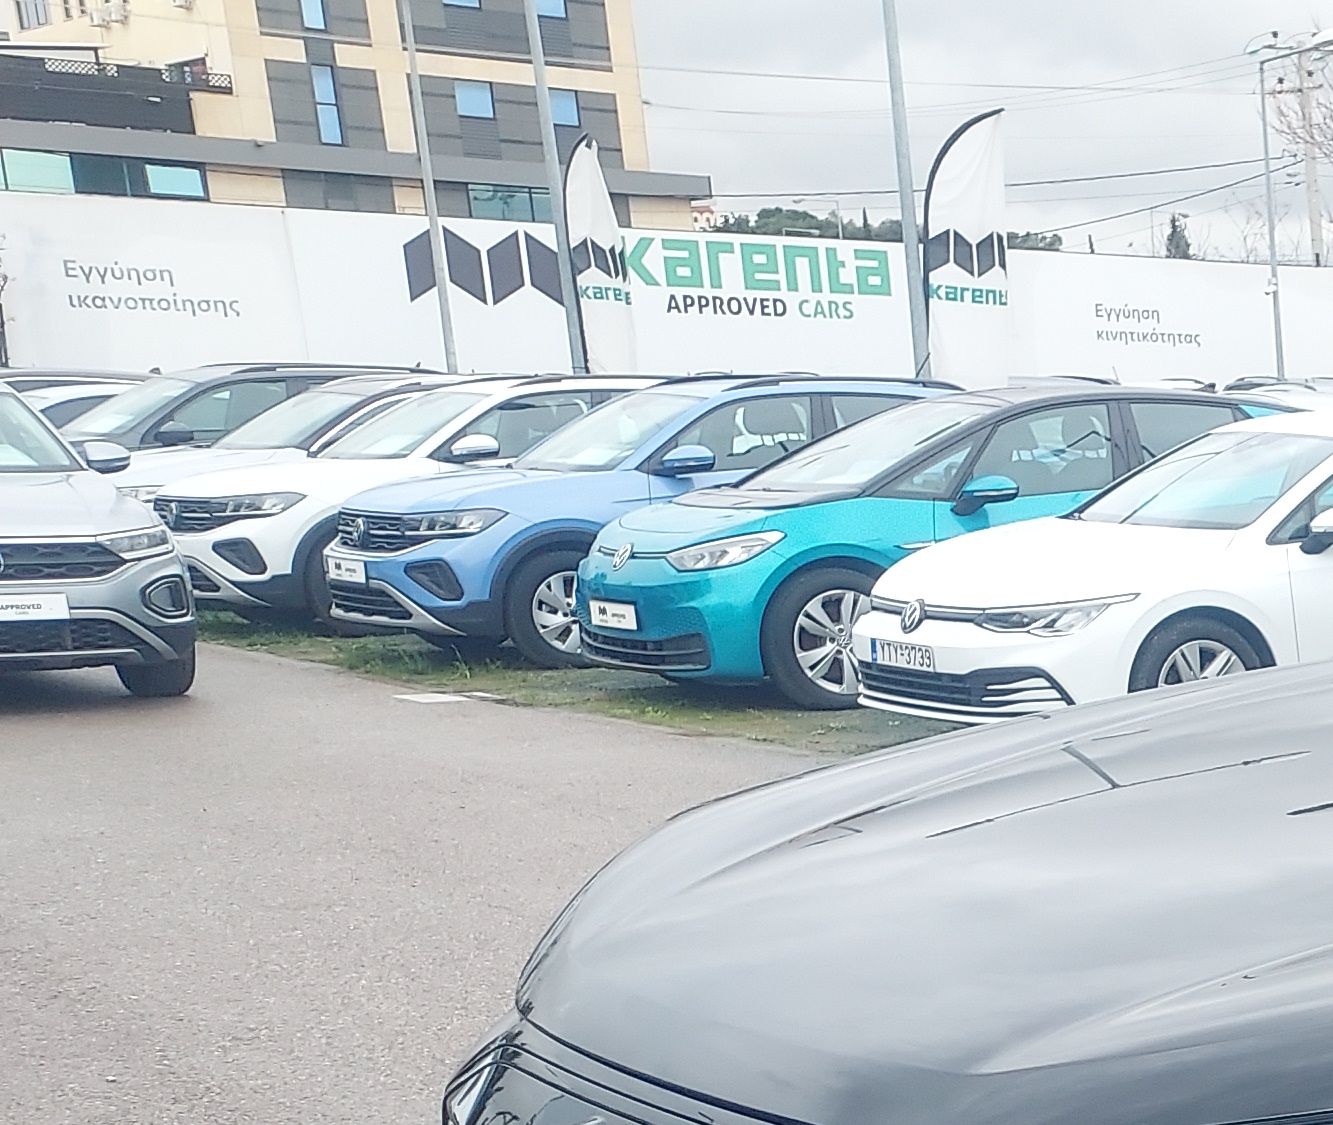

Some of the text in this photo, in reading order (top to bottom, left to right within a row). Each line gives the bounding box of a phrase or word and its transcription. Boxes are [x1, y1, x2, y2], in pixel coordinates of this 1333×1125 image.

[63, 259, 174, 287] Εγγύηση
[620, 235, 892, 297] karenta
[68, 292, 241, 318] ικανοποίησης
[666, 293, 855, 319] APPROVED CARS
[1095, 303, 1160, 324] Εγγύηση
[1096, 327, 1201, 348] κινητικότητας
